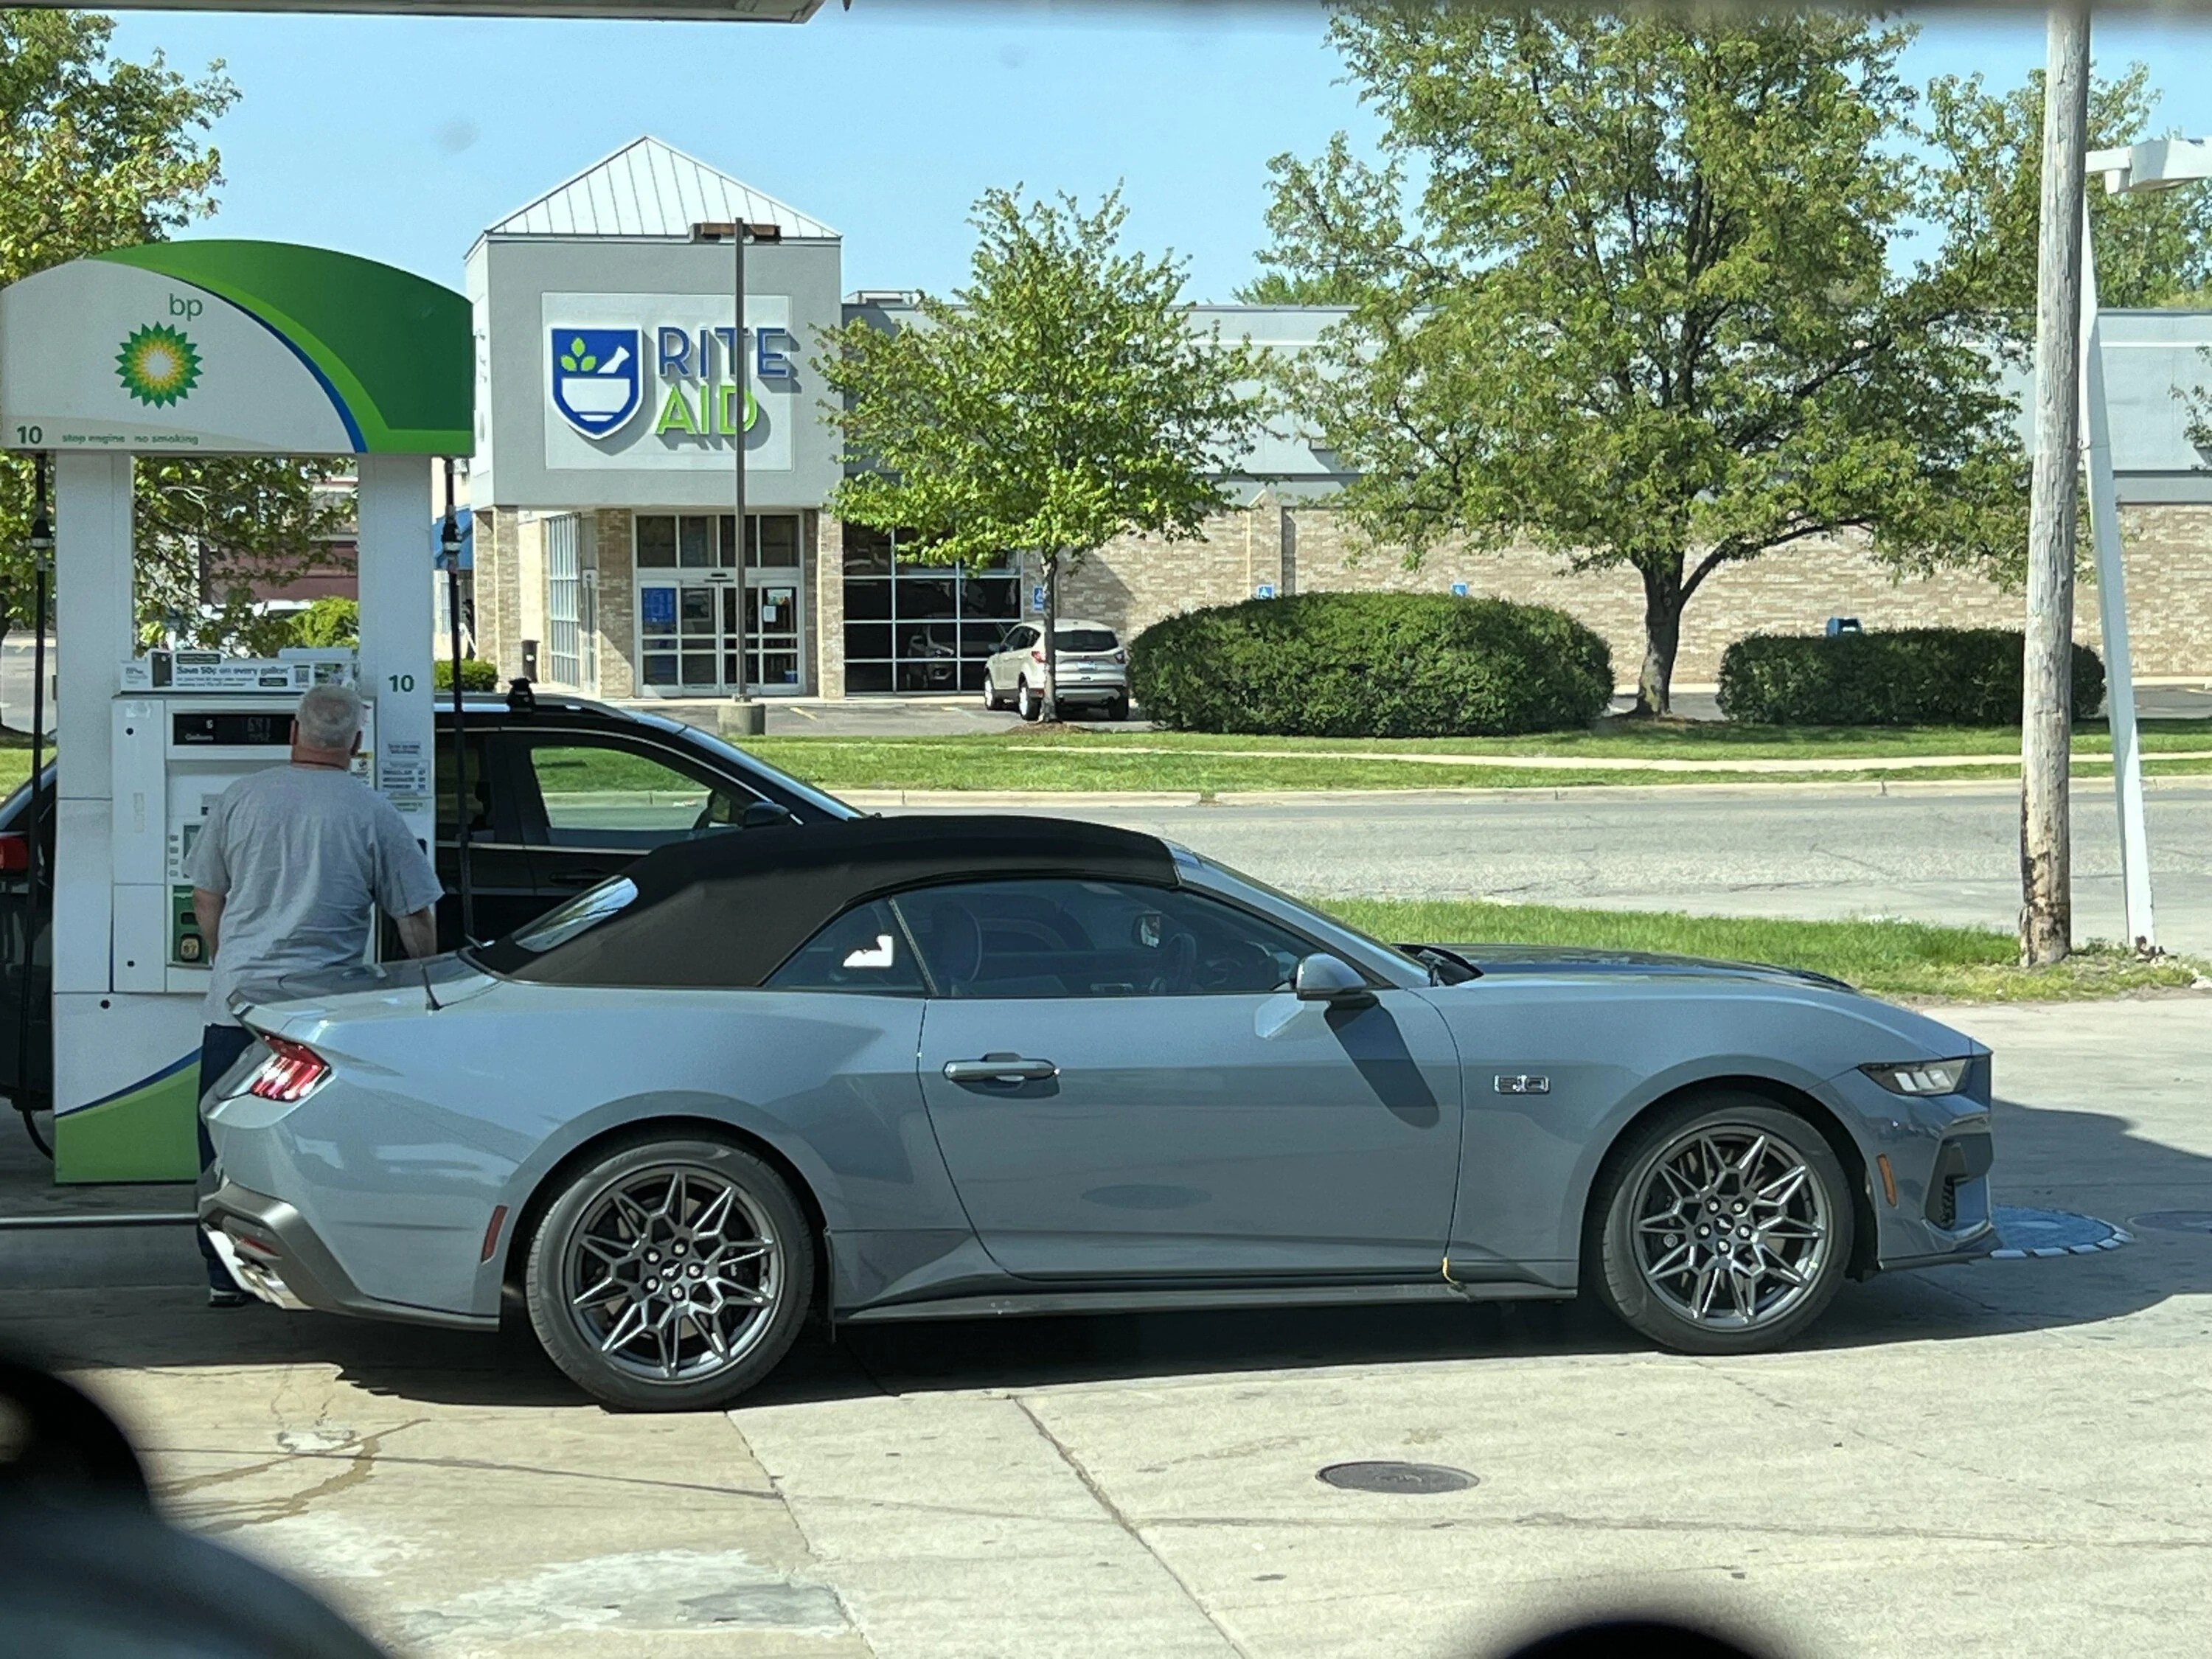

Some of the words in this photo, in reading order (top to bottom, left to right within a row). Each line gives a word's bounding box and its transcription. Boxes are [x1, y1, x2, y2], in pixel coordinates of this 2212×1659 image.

[170, 293, 203, 322] bp
[657, 326, 788, 379] RITE
[655, 383, 759, 435] AID
[16, 425, 43, 445] 10
[388, 674, 414, 692] 10
